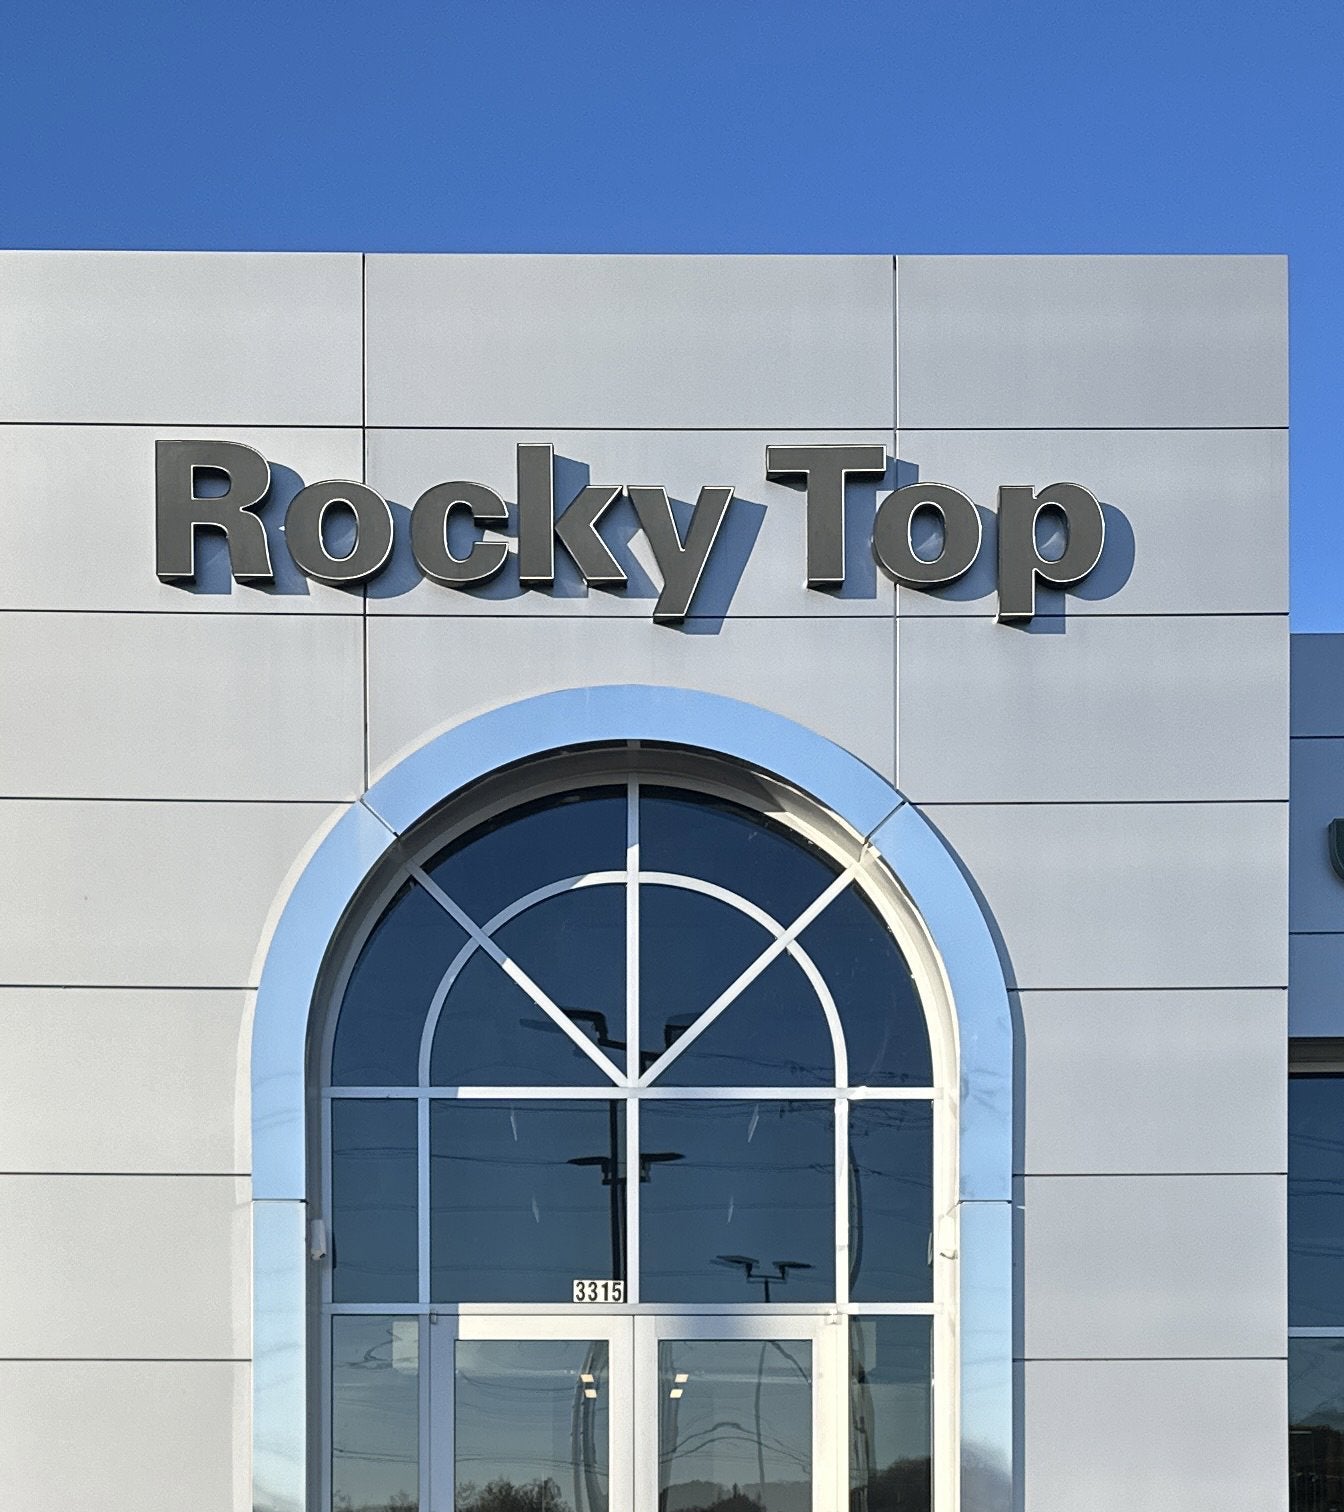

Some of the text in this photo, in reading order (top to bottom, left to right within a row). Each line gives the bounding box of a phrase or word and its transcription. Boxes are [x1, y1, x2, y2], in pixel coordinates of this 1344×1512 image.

[154, 440, 1106, 624] Rocky Top
[576, 1281, 622, 1302] 3315
